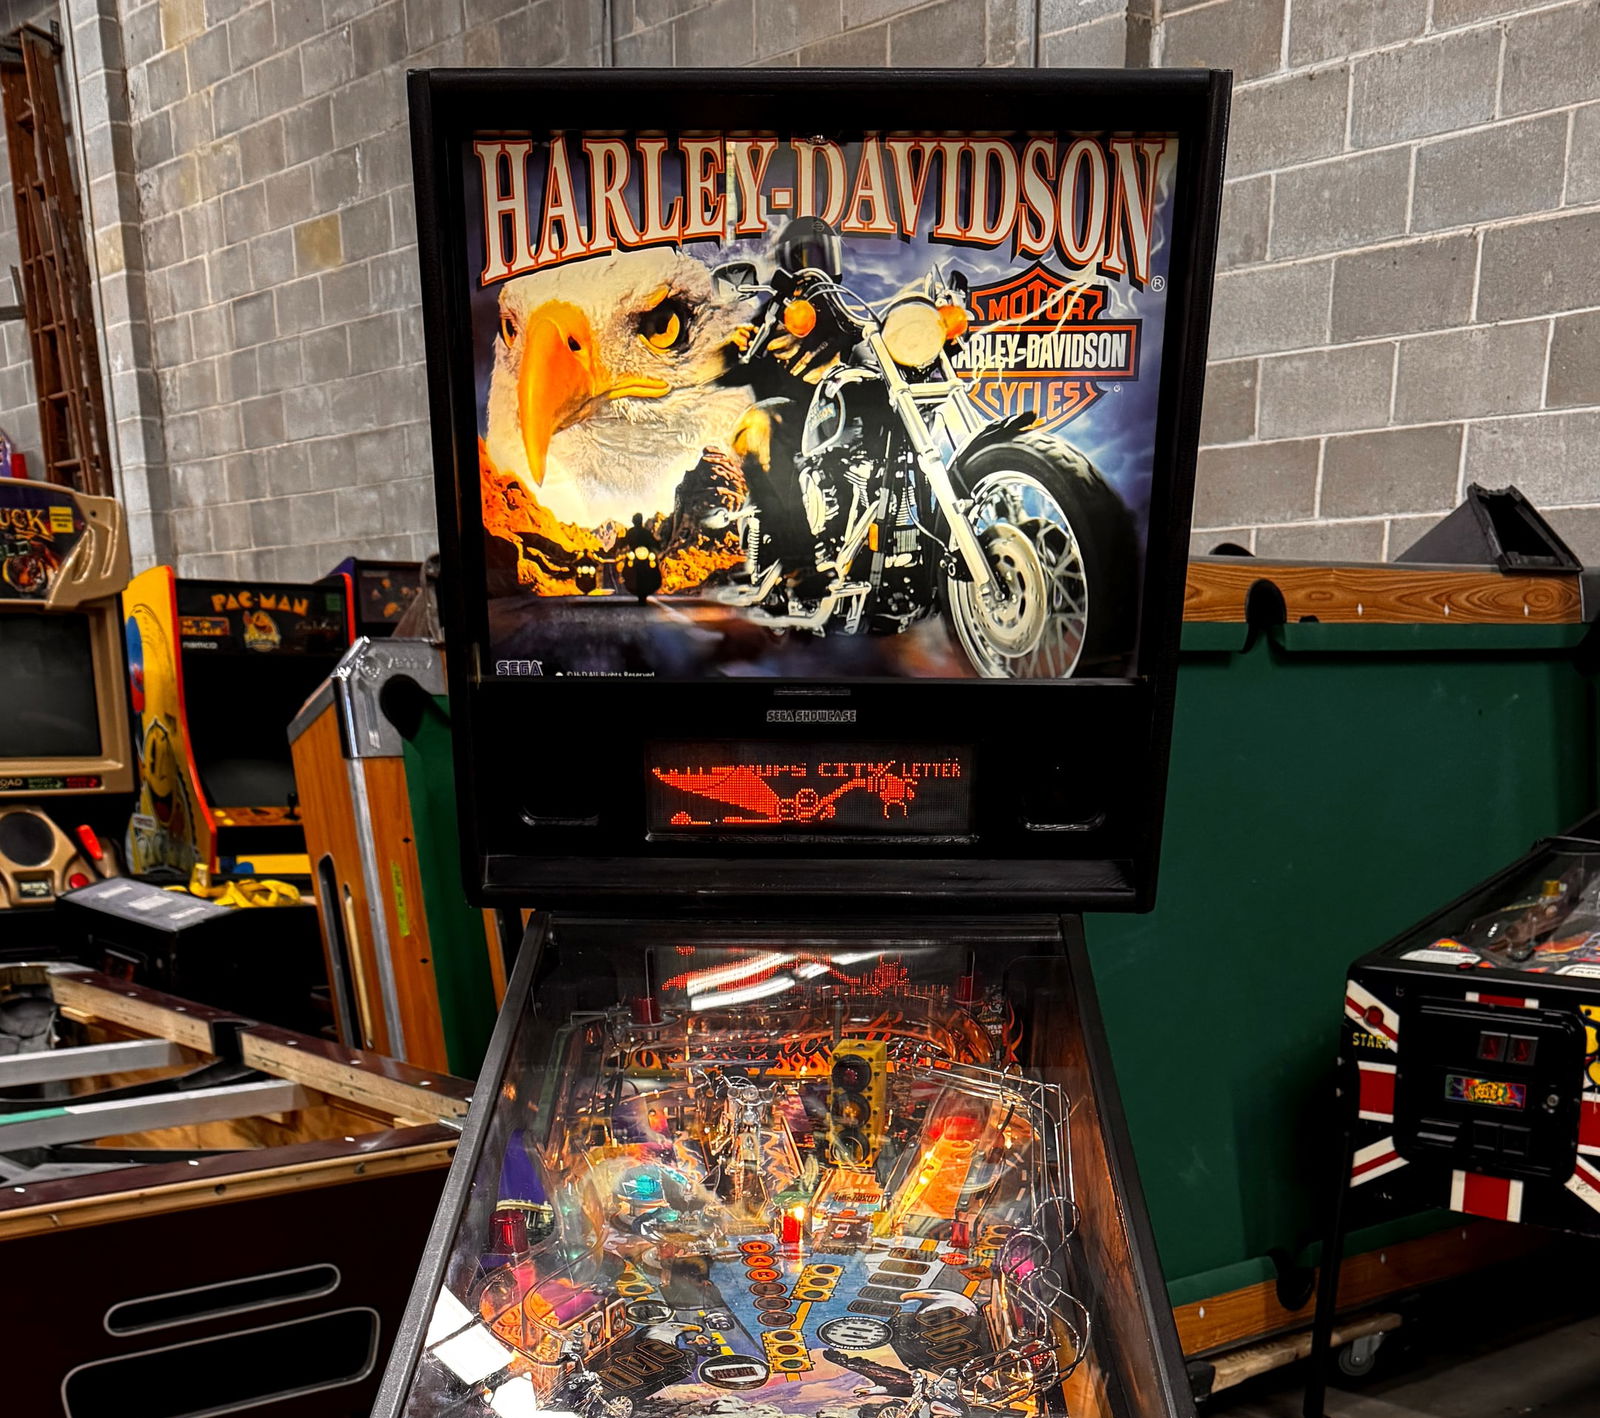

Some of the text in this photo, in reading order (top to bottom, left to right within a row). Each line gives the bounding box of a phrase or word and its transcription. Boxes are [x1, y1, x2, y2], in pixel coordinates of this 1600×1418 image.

[473, 136, 1166, 288] HARLEY-DAVIDSON
[988, 279, 1085, 321] MOTOR
[984, 381, 1081, 421] CYCLES
[211, 591, 309, 617] PAC-MAN
[496, 660, 544, 677] SEGA
[766, 709, 857, 722] SEGA SHOWCASE
[818, 762, 885, 777] CITY
[902, 762, 961, 777] LETTER
[1352, 1031, 1391, 1050] START
